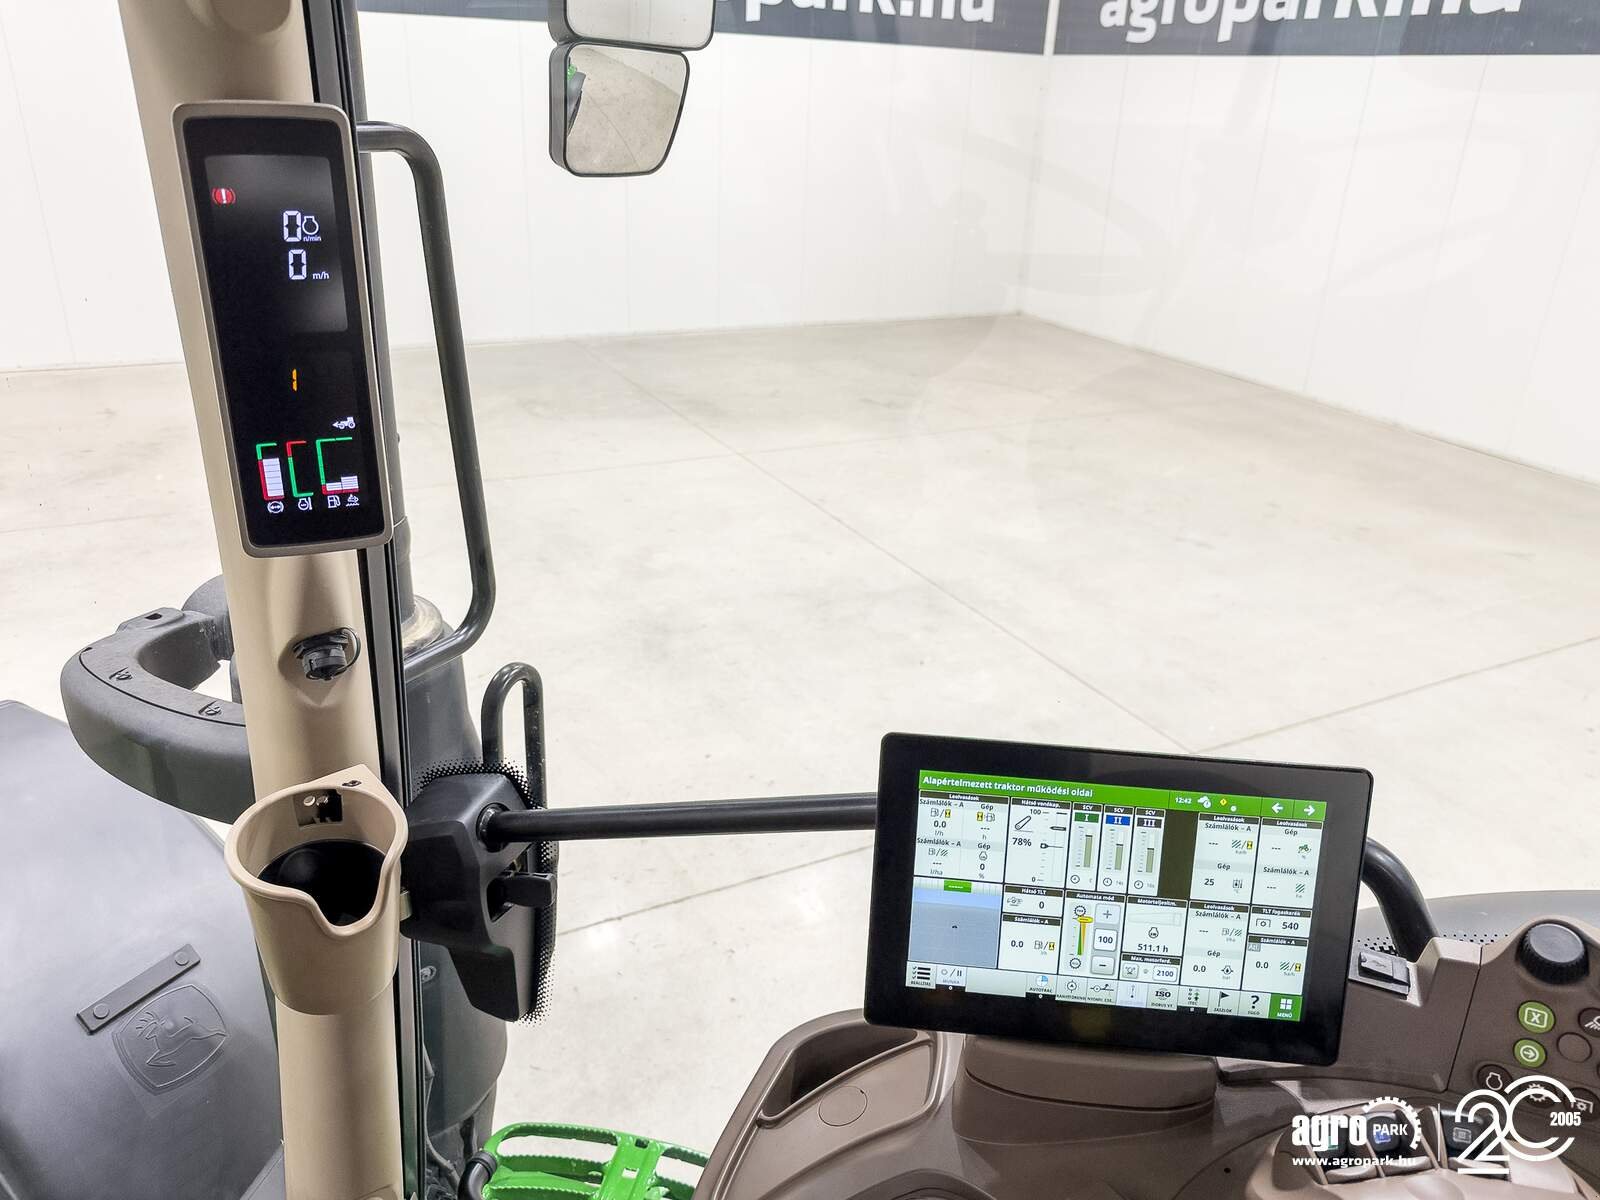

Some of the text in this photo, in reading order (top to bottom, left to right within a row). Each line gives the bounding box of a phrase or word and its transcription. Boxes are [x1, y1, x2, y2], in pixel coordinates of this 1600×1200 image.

[283, 210, 302, 242] 0
[288, 249, 307, 280] 0
[312, 271, 330, 280] m/h
[923, 776, 1093, 798] Alapértelmezett traktor működési oldal
[980, 803, 994, 811] Gép
[933, 820, 947, 828] 0.0
[1205, 822, 1239, 831] Számlálók
[1012, 837, 1032, 847] 78%
[1217, 862, 1231, 871] Gép
[1263, 866, 1297, 875] Számlálók
[1204, 878, 1215, 886] 25
[1038, 901, 1045, 909] 0
[1195, 910, 1229, 919] Számlálók
[1282, 922, 1299, 930] 540
[1010, 940, 1024, 948] 0.0
[1098, 936, 1113, 944] 100
[1137, 943, 1161, 952] 511.1
[1207, 950, 1221, 958] Gép
[1193, 965, 1206, 973] 0.0
[1255, 961, 1269, 969] 0.0
[1155, 990, 1171, 998] ISO
